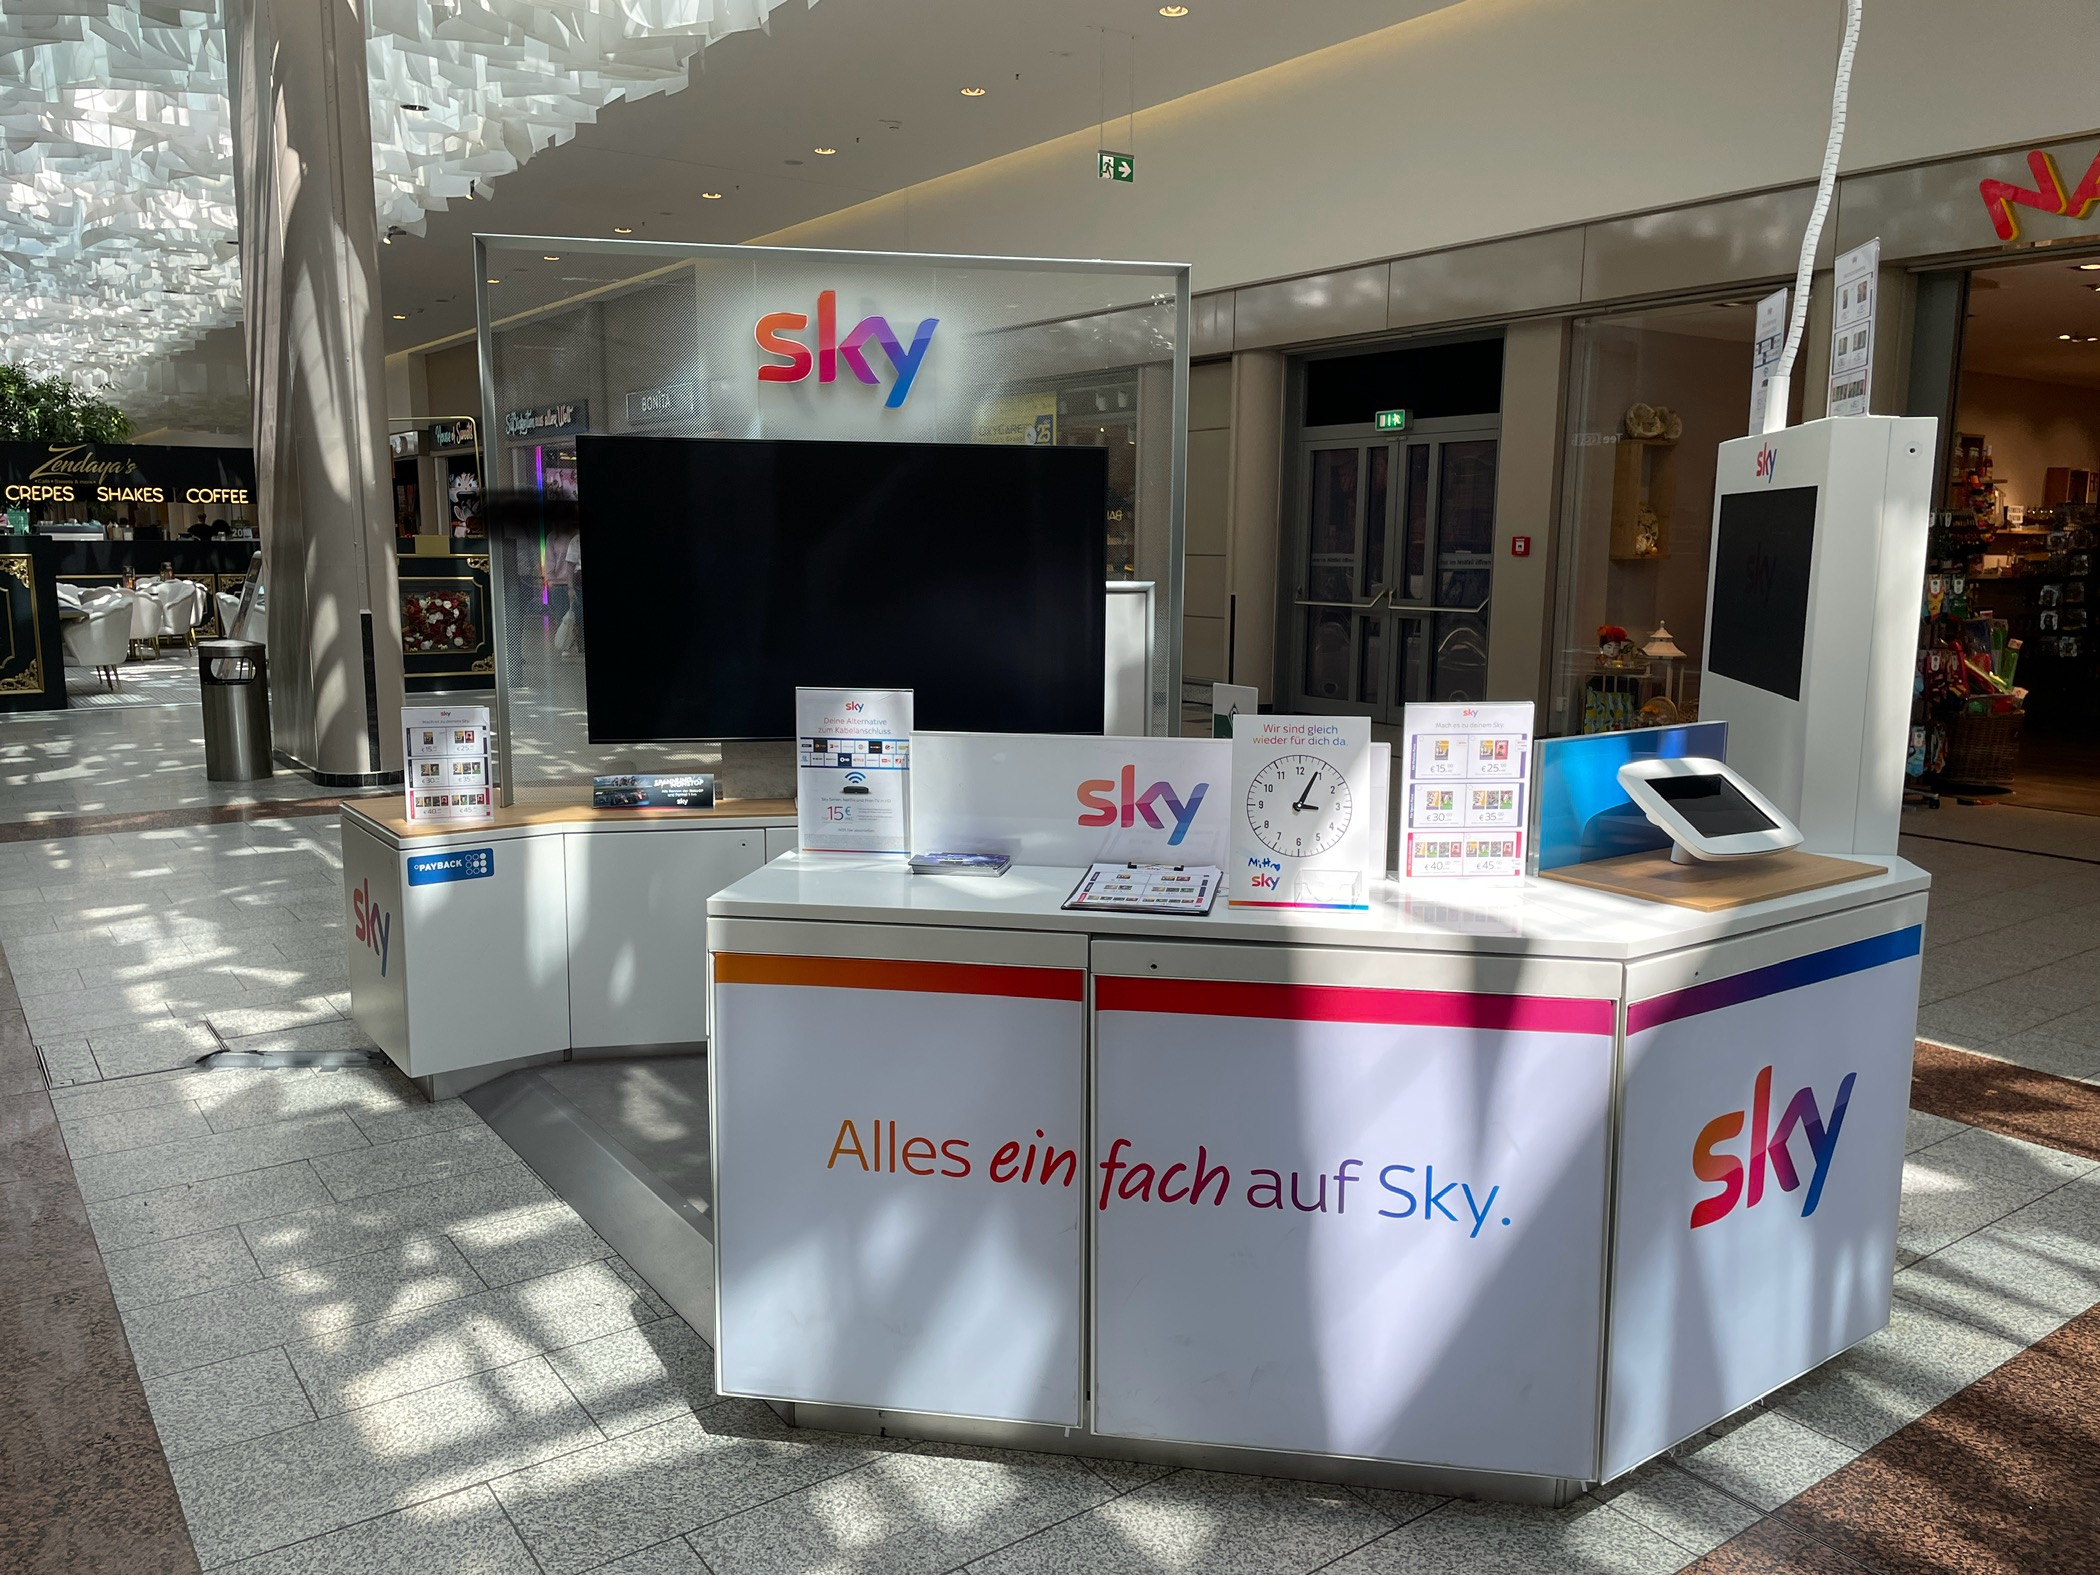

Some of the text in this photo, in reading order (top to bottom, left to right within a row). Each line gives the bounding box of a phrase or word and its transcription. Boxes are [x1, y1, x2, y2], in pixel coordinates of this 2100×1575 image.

[754, 289, 940, 409] sky
[29, 443, 138, 485] Zendaya's
[1756, 442, 1777, 483] sky
[5, 485, 75, 502] CREPES
[97, 486, 164, 503] SHAKES
[186, 488, 249, 504] COFFEE
[845, 701, 864, 713] sky
[1463, 709, 1478, 718] sky
[823, 717, 845, 725] Deine
[1263, 724, 1338, 736] Wir sind gleich
[1252, 735, 1288, 745] wieder
[1290, 735, 1305, 745] für
[1308, 737, 1330, 746] dich
[1277, 771, 1285, 779] 11
[1296, 767, 1305, 775] 12
[1318, 772, 1322, 780] 1
[1264, 784, 1273, 792] 10
[1330, 786, 1335, 794] 2
[676, 798, 688, 806] sky
[1077, 764, 1209, 846] sky
[1258, 800, 1264, 809] 9
[1335, 803, 1340, 811] 3
[1264, 820, 1269, 828] 8
[1329, 822, 1334, 831] 4
[1277, 832, 1282, 840] 7
[1315, 833, 1320, 841] 5
[1296, 838, 1301, 846] 6
[419, 859, 462, 872] PAYBACK
[1251, 873, 1281, 891] sky
[353, 877, 391, 978] sky
[1690, 1065, 1857, 1229] sky
[827, 1119, 971, 1178] Alles
[1246, 1159, 1364, 1215] auf
[1378, 1165, 1511, 1239] Sky.
